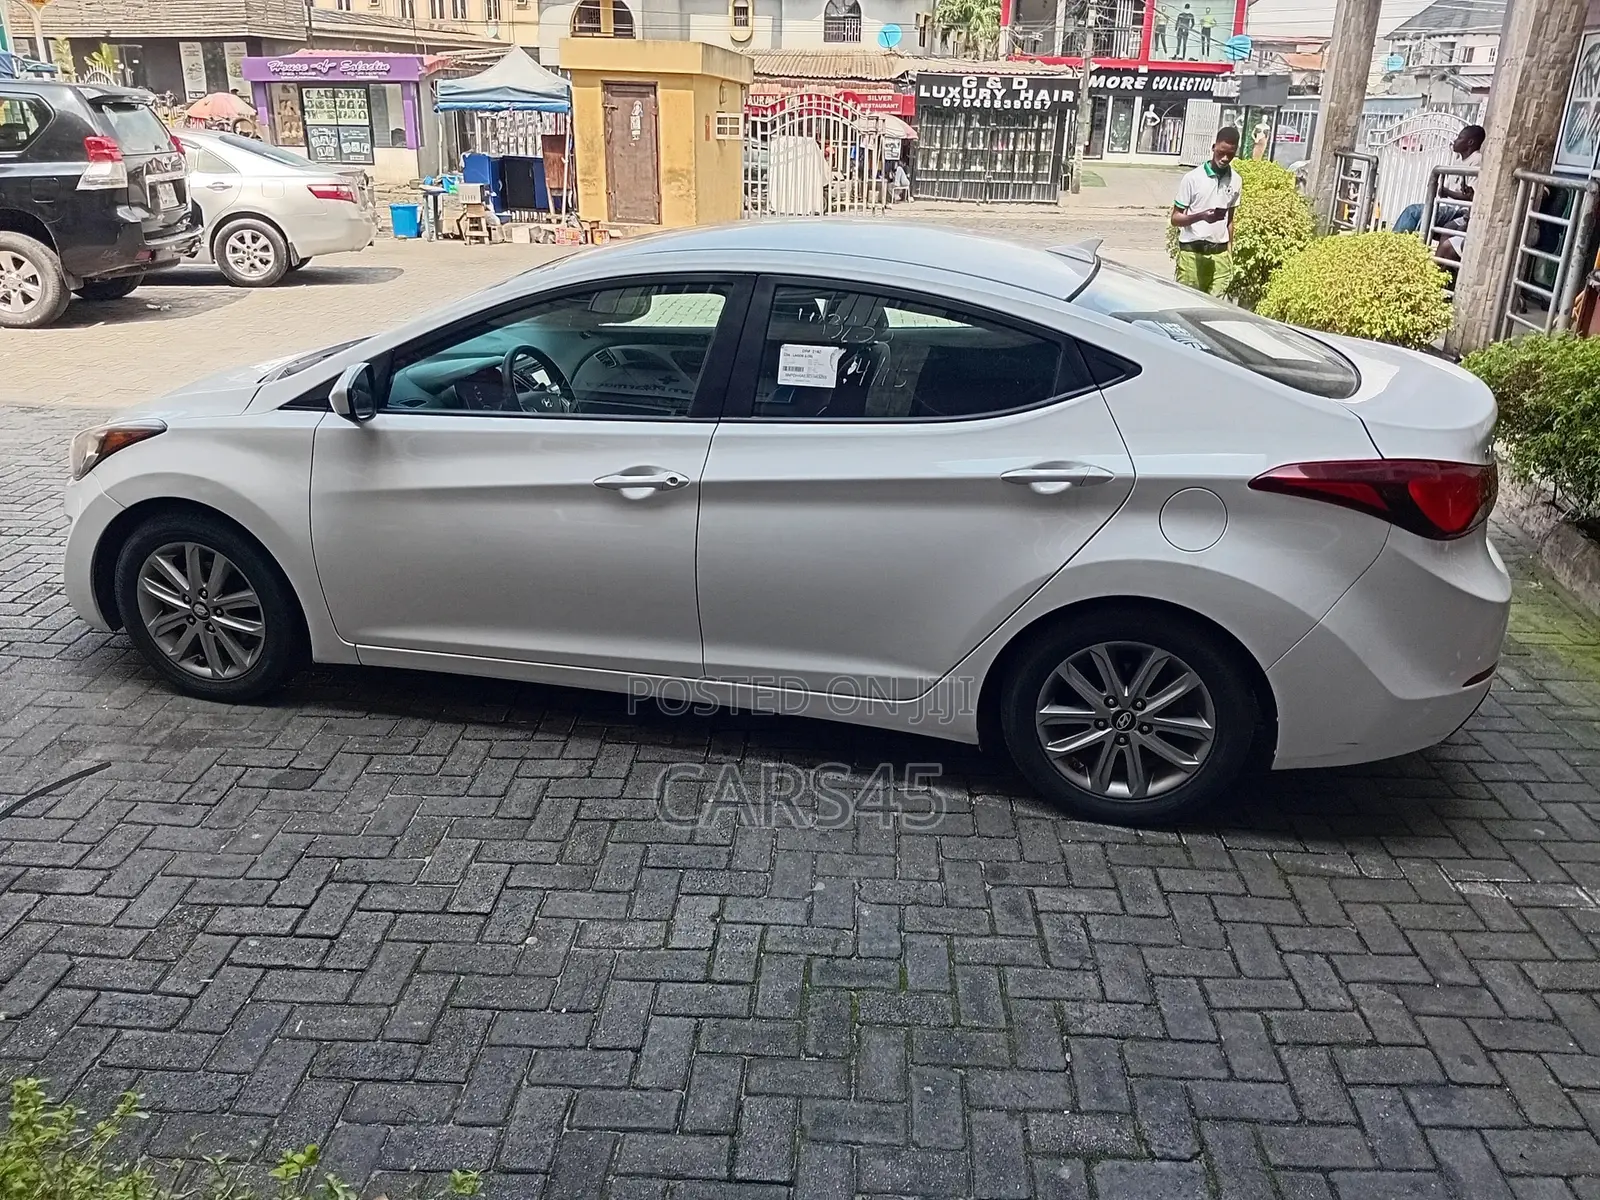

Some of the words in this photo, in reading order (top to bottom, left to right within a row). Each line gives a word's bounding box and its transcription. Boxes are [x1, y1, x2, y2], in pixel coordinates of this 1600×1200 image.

[962, 76, 978, 88] G
[986, 77, 1002, 89] &
[1012, 78, 1028, 90] D
[919, 85, 1007, 100] LUXURY
[1019, 90, 1075, 103] HAIR
